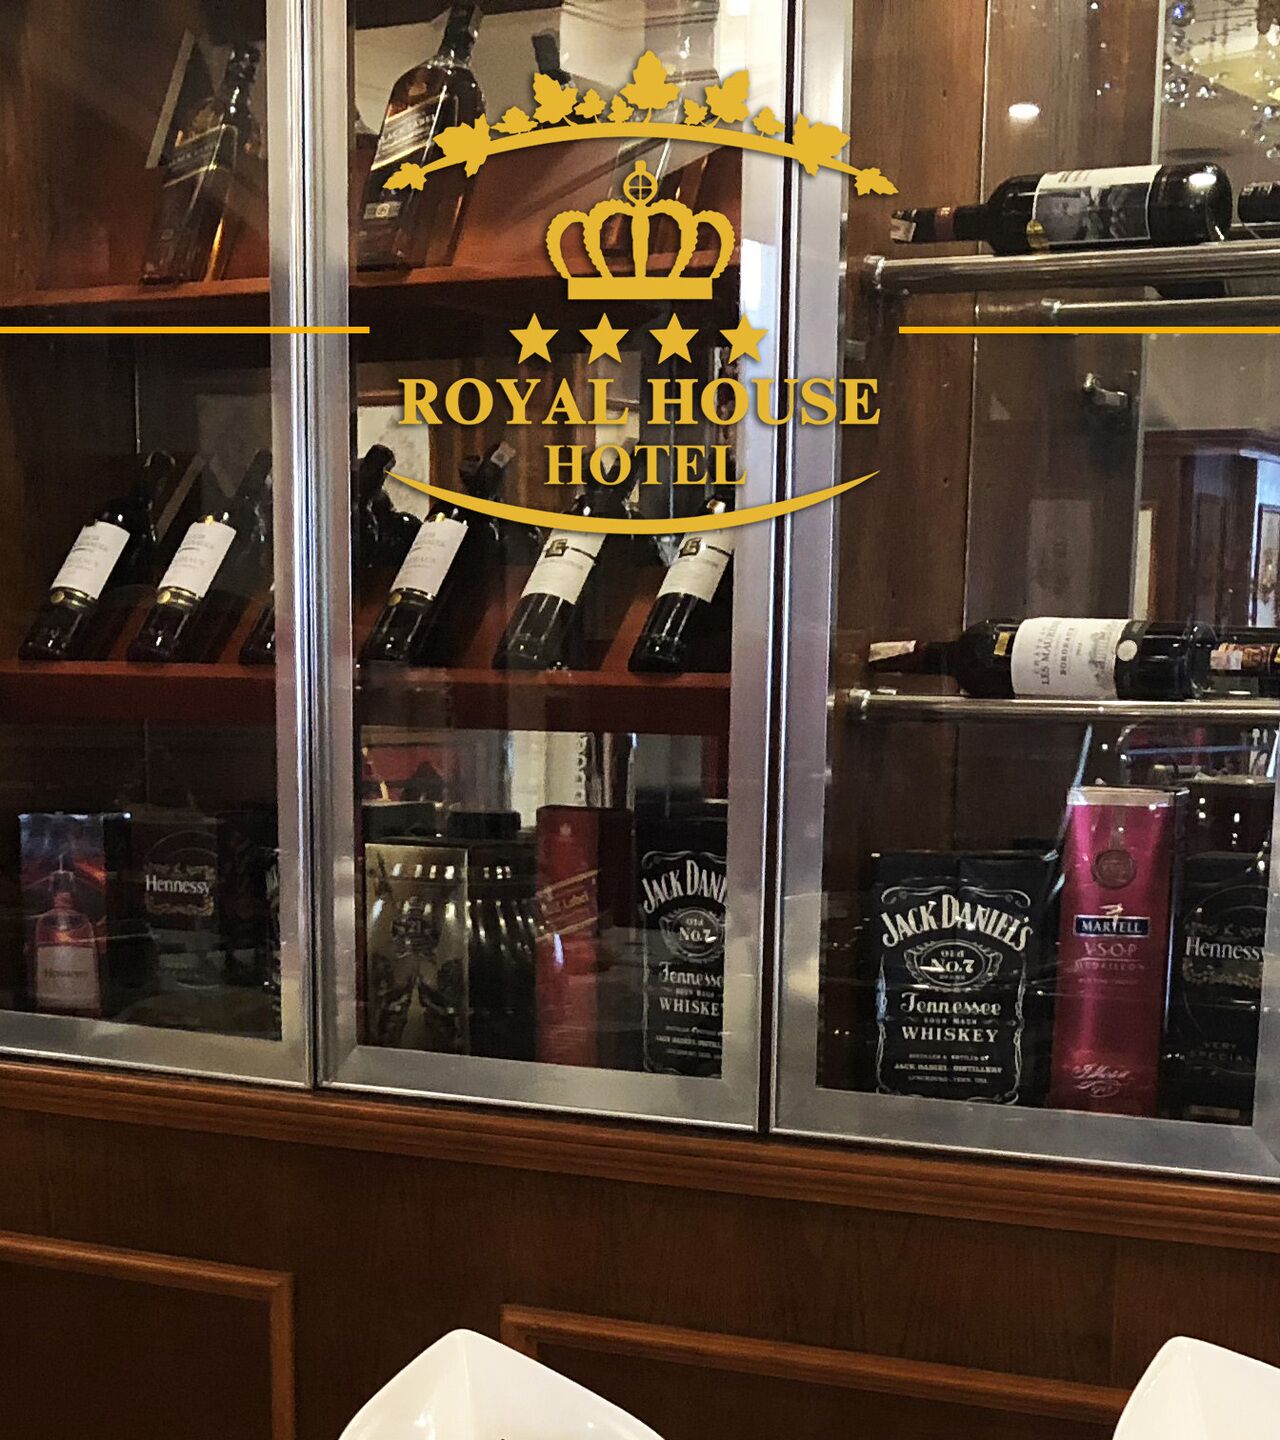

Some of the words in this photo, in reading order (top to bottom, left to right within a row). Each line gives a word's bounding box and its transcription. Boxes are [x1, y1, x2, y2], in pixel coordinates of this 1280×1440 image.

[145, 873, 211, 896] Hennessy
[641, 869, 683, 915] JACK
[880, 900, 938, 948] JACK
[941, 893, 1034, 952] DANIEL'S
[1081, 919, 1142, 934] MARTELL
[927, 958, 975, 974] No.7
[658, 997, 724, 1016] WHISKE
[900, 992, 1002, 1016] Tennessee
[901, 1026, 999, 1043] WHISKEY
